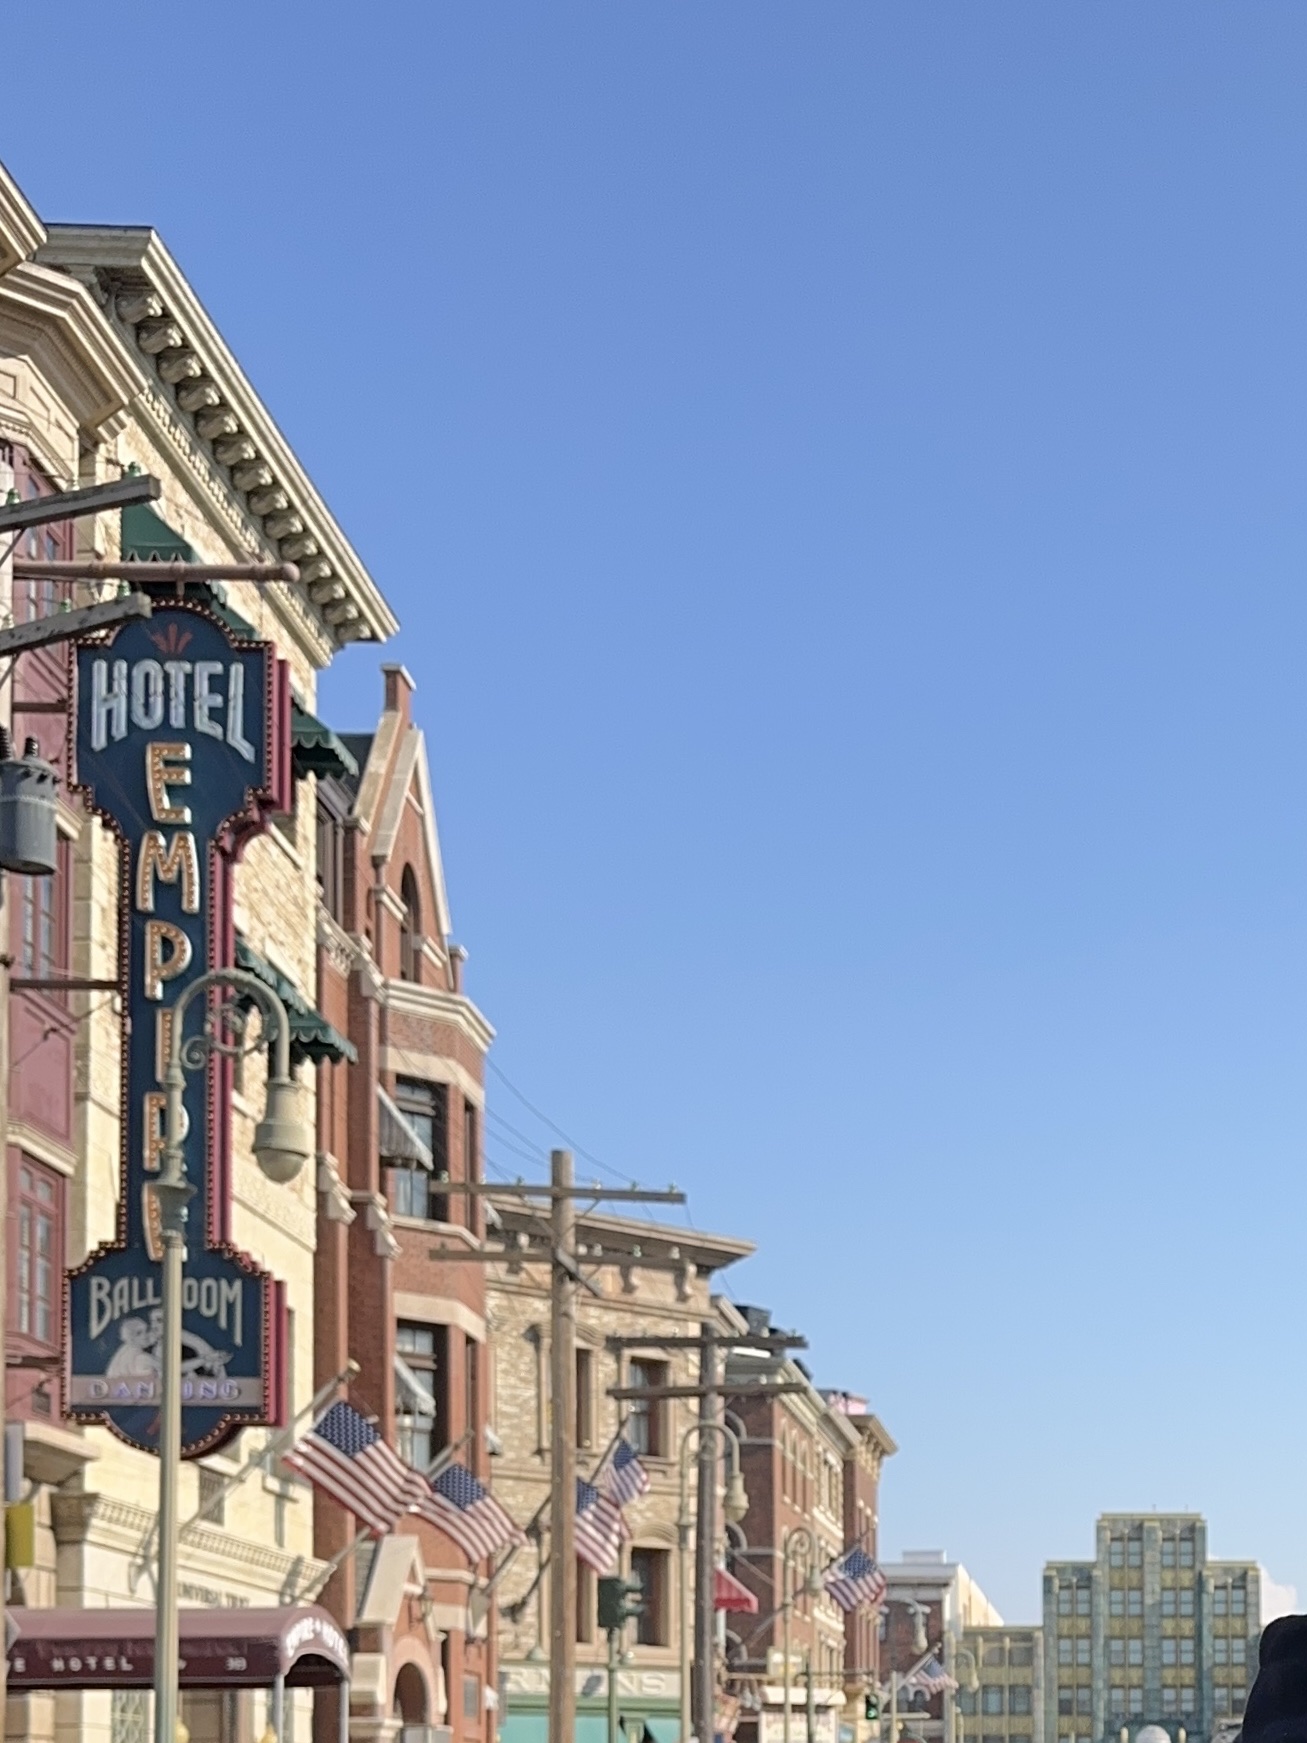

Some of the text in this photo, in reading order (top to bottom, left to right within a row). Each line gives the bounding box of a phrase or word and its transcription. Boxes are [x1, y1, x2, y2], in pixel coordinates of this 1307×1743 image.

[91, 658, 255, 764] HOTEL
[89, 1276, 243, 1347] BALLOOM
[90, 1379, 242, 1400] DANING
[51, 1655, 134, 1673] HOTEL
